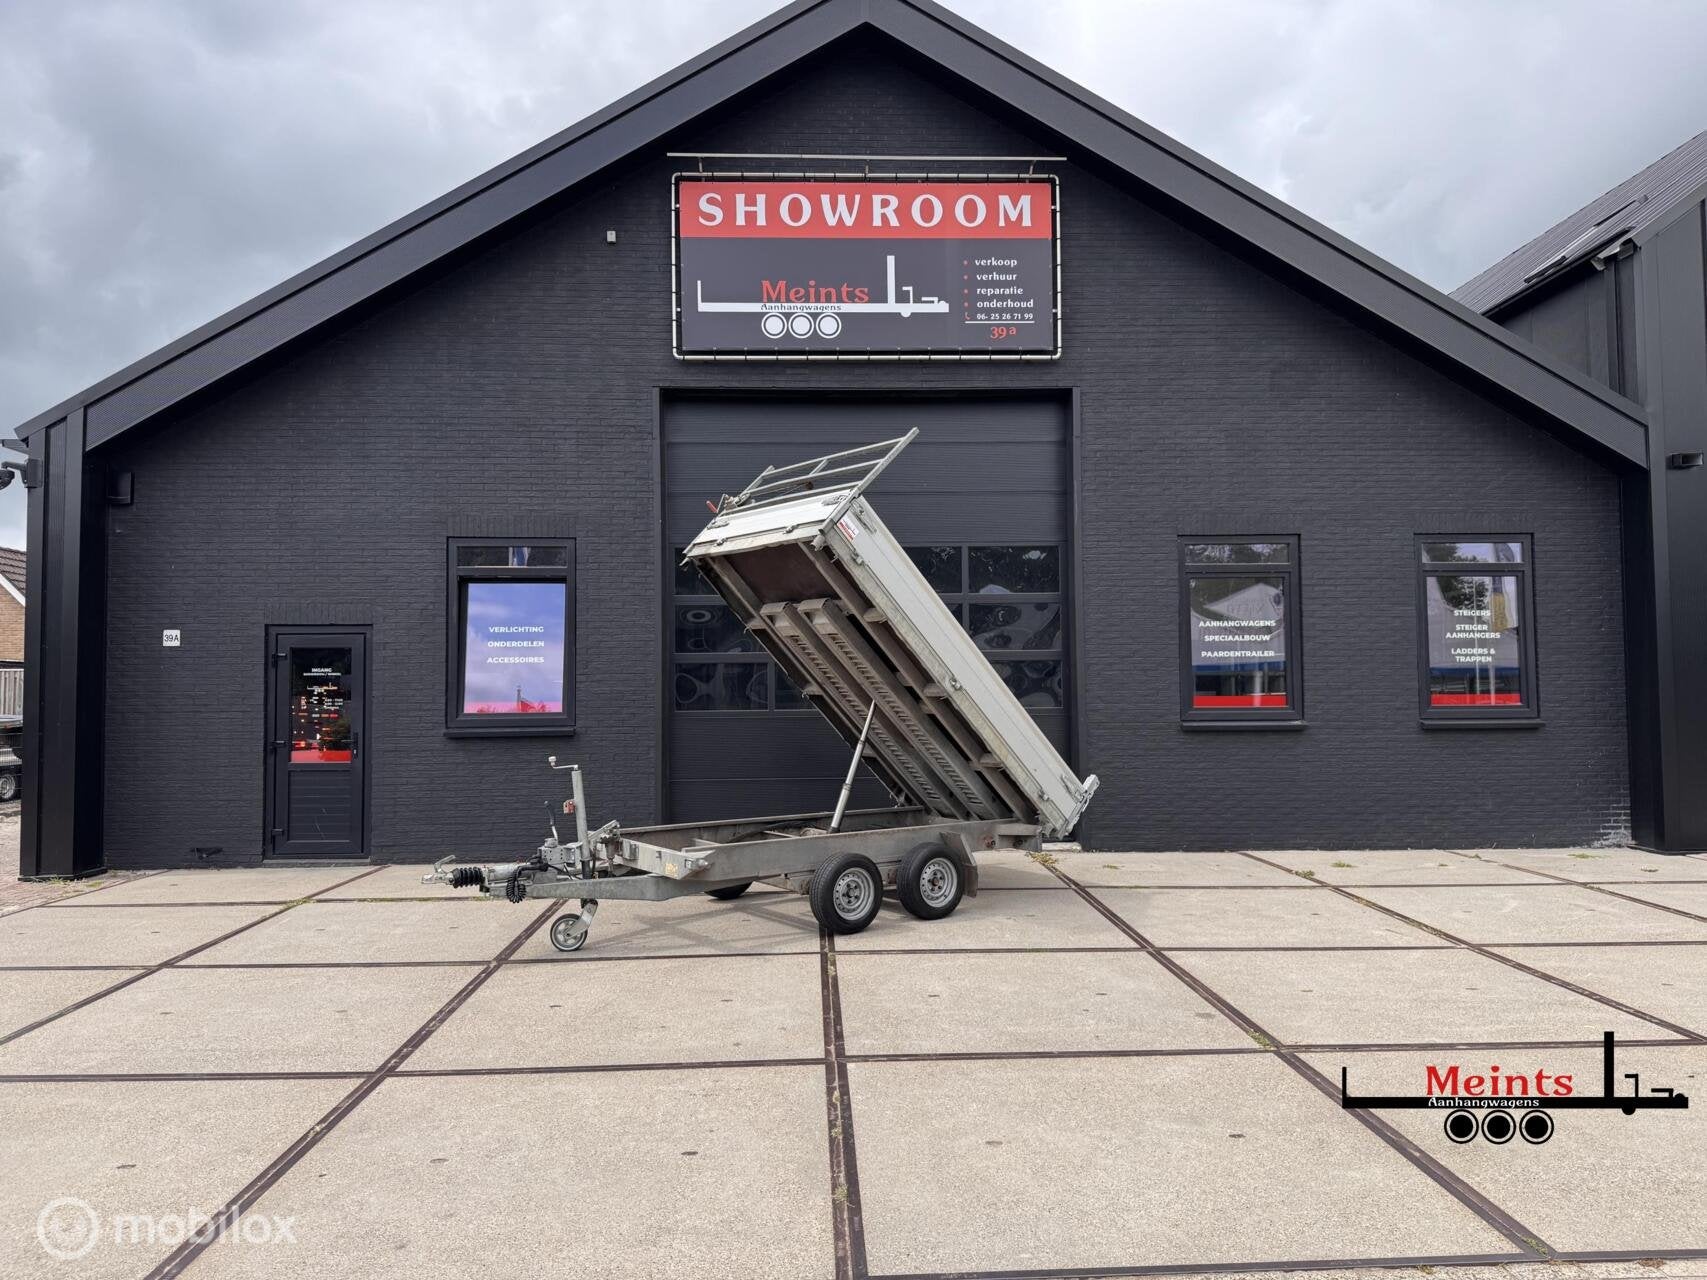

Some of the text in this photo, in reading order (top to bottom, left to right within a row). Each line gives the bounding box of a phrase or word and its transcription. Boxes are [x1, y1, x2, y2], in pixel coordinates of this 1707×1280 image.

[698, 192, 1032, 228] SHOWROOM
[975, 256, 1018, 268] verkoop
[976, 272, 1018, 281] verhuur
[761, 279, 870, 304] Meints
[976, 286, 1024, 296] reparatie
[761, 303, 842, 313] Aanhangwagens
[976, 299, 1034, 308] onderhoud
[1453, 609, 1491, 617] STEIGERS
[164, 634, 179, 642] 39A
[1204, 634, 1271, 642] SPECIAALBOUW
[487, 640, 545, 648] ONDERDELEN
[486, 656, 545, 664] ACCESSOIRES
[1454, 655, 1492, 663] TRAPPEN
